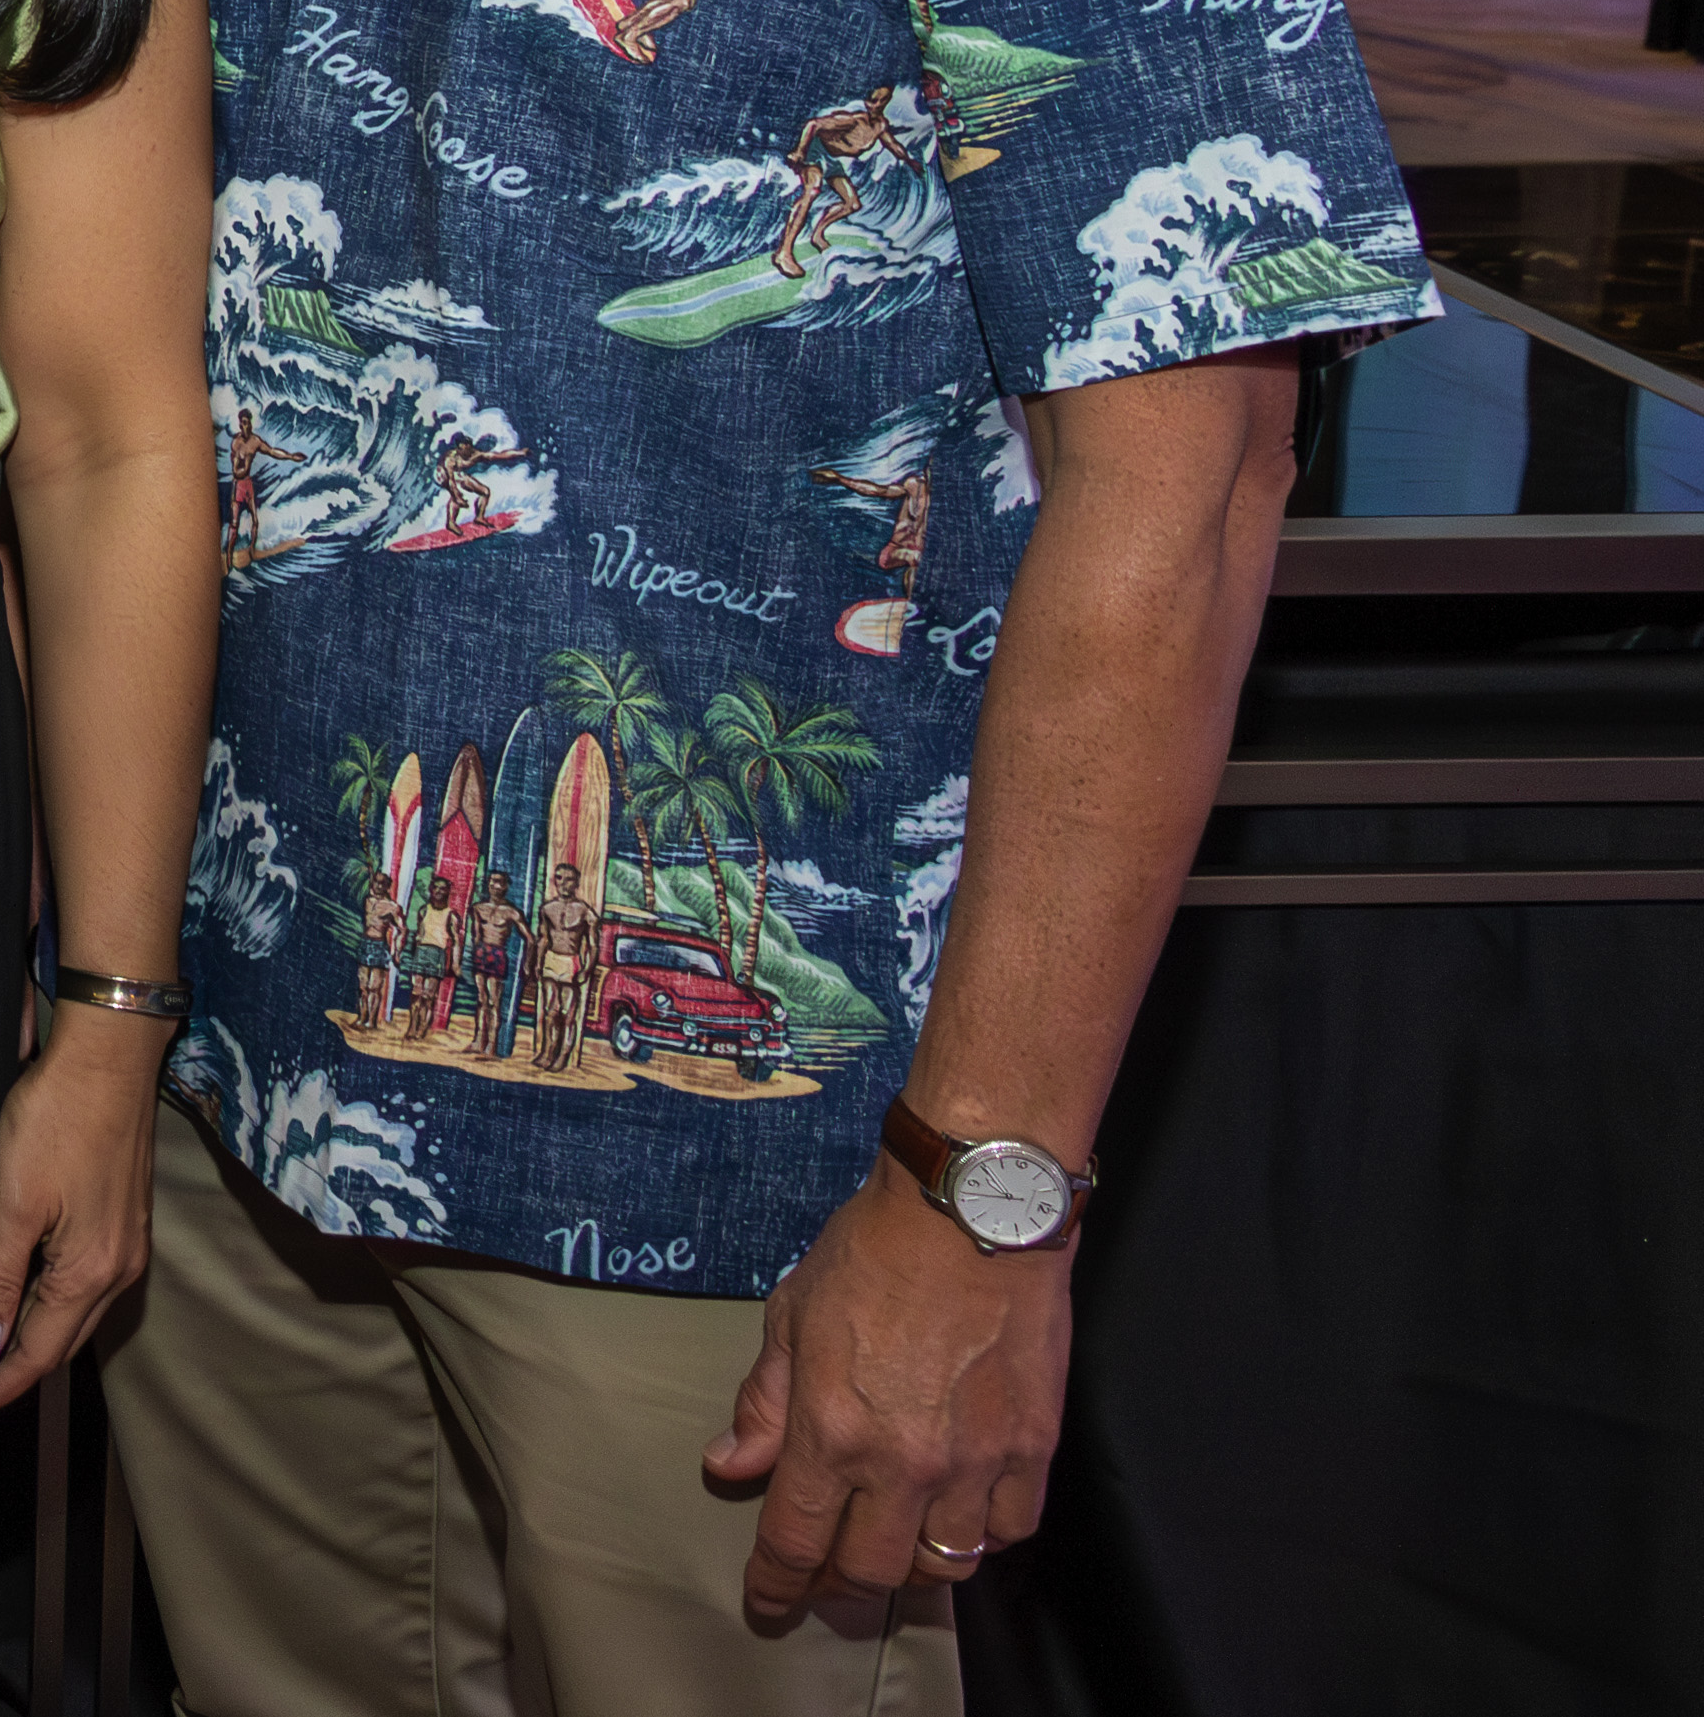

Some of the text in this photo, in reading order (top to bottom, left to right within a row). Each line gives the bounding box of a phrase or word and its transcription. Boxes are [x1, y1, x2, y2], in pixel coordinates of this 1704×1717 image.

[283, 4, 534, 199] Hang Loose
[589, 525, 796, 623] Wipeout
[927, 605, 1001, 677] Lo
[544, 1218, 696, 1282] Nose
